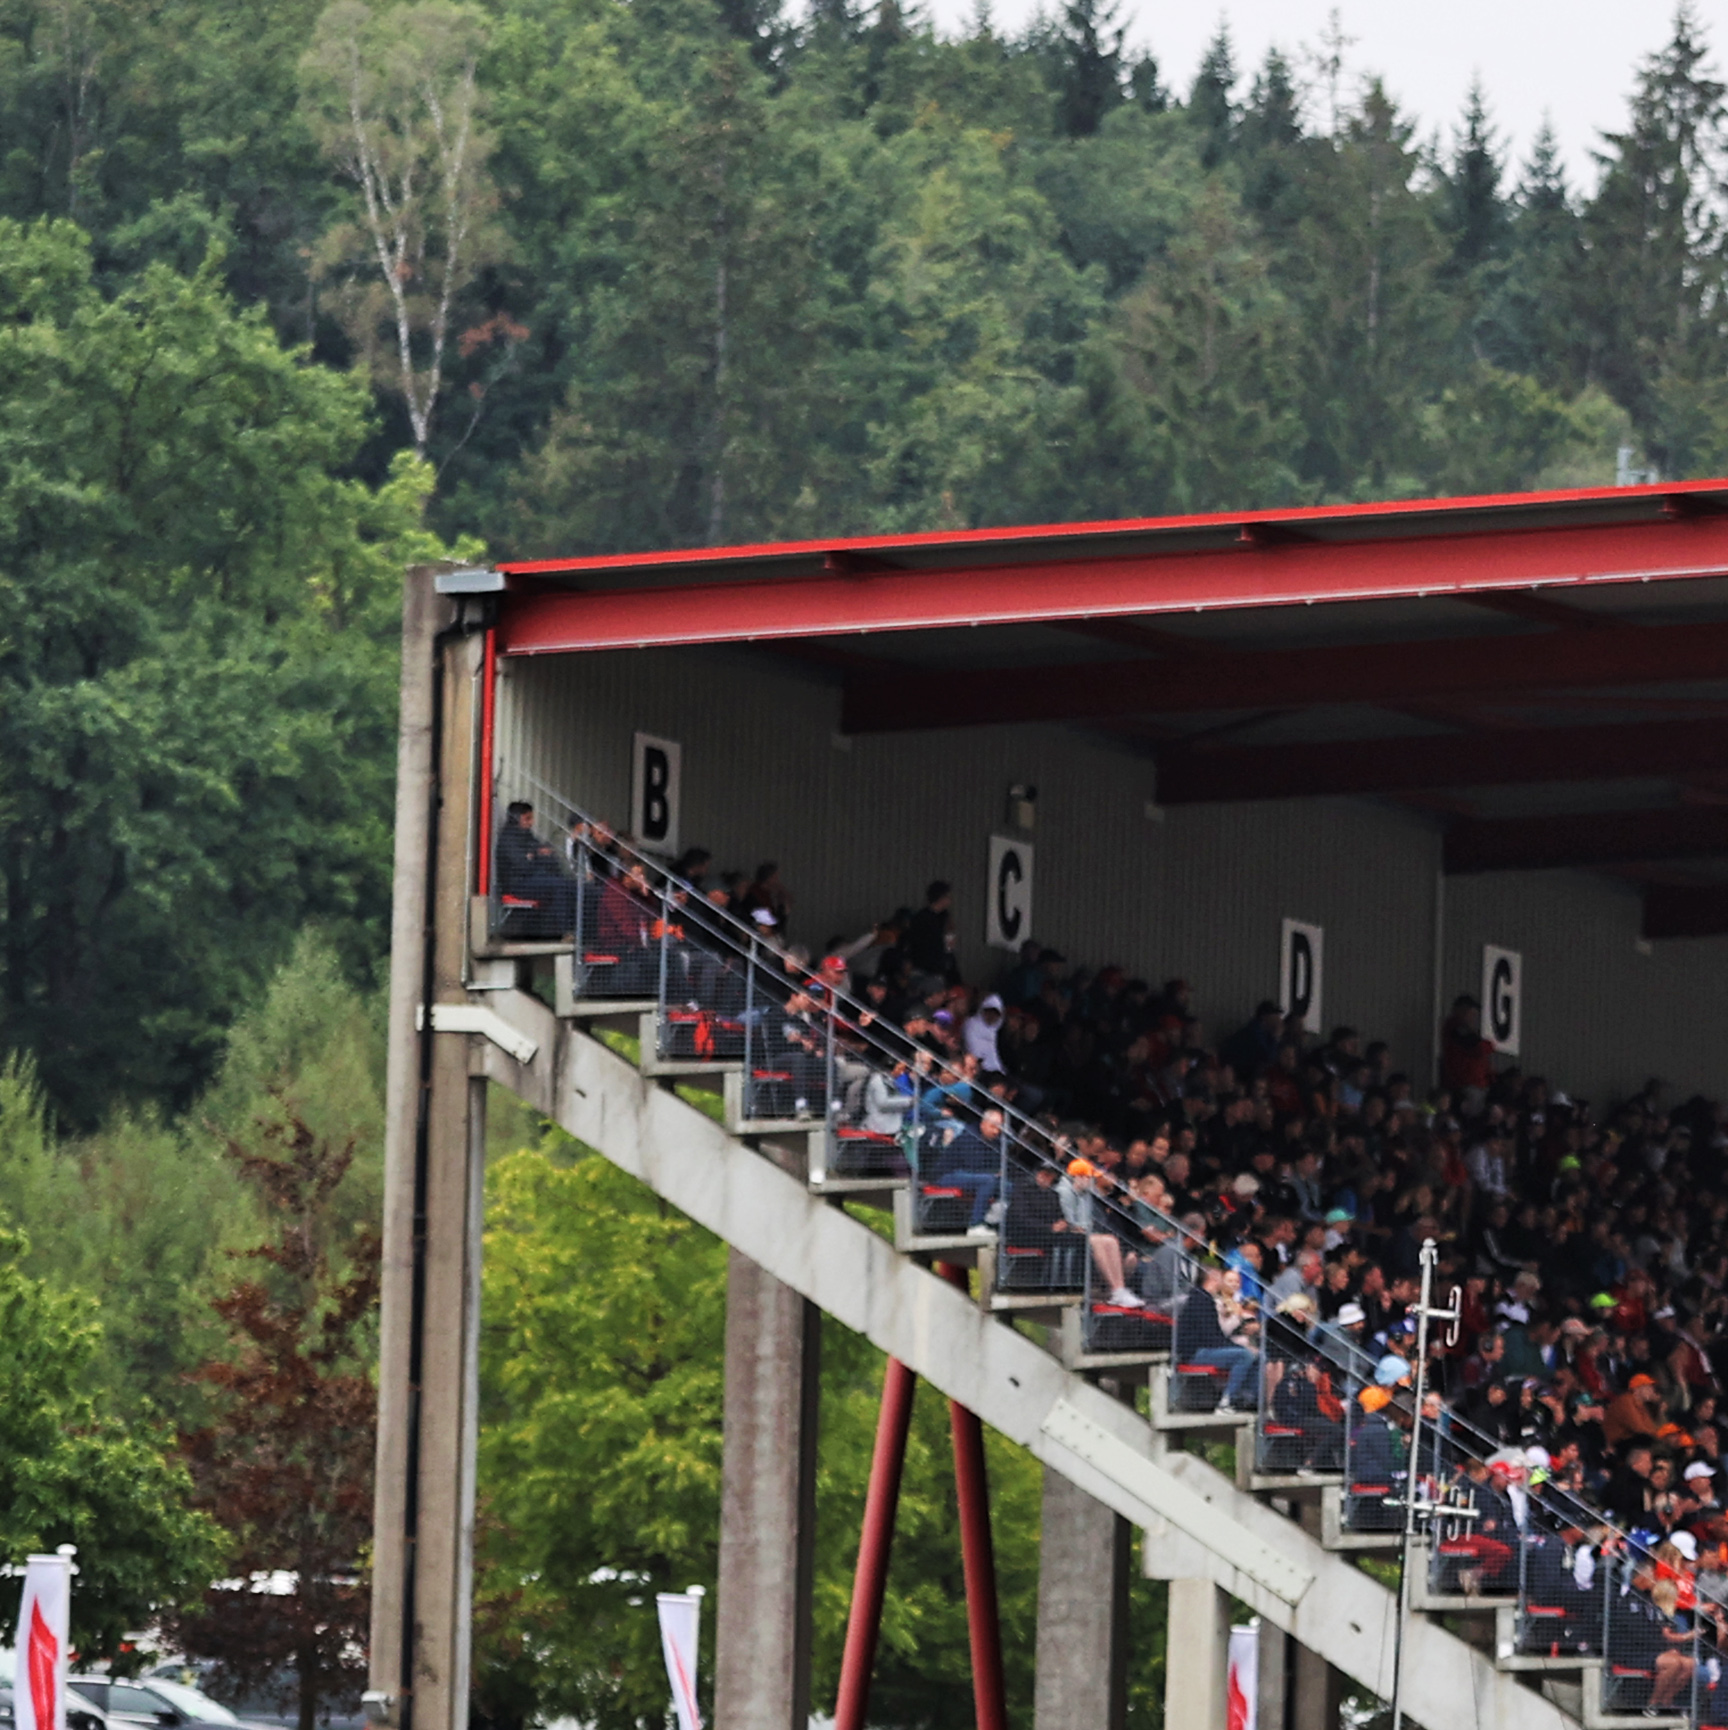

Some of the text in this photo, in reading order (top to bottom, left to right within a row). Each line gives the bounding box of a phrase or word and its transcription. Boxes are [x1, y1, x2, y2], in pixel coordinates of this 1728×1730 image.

[645, 745, 669, 839] B
[998, 850, 1022, 941] C
[1291, 931, 1311, 1016] D
[1491, 956, 1511, 1042] G
